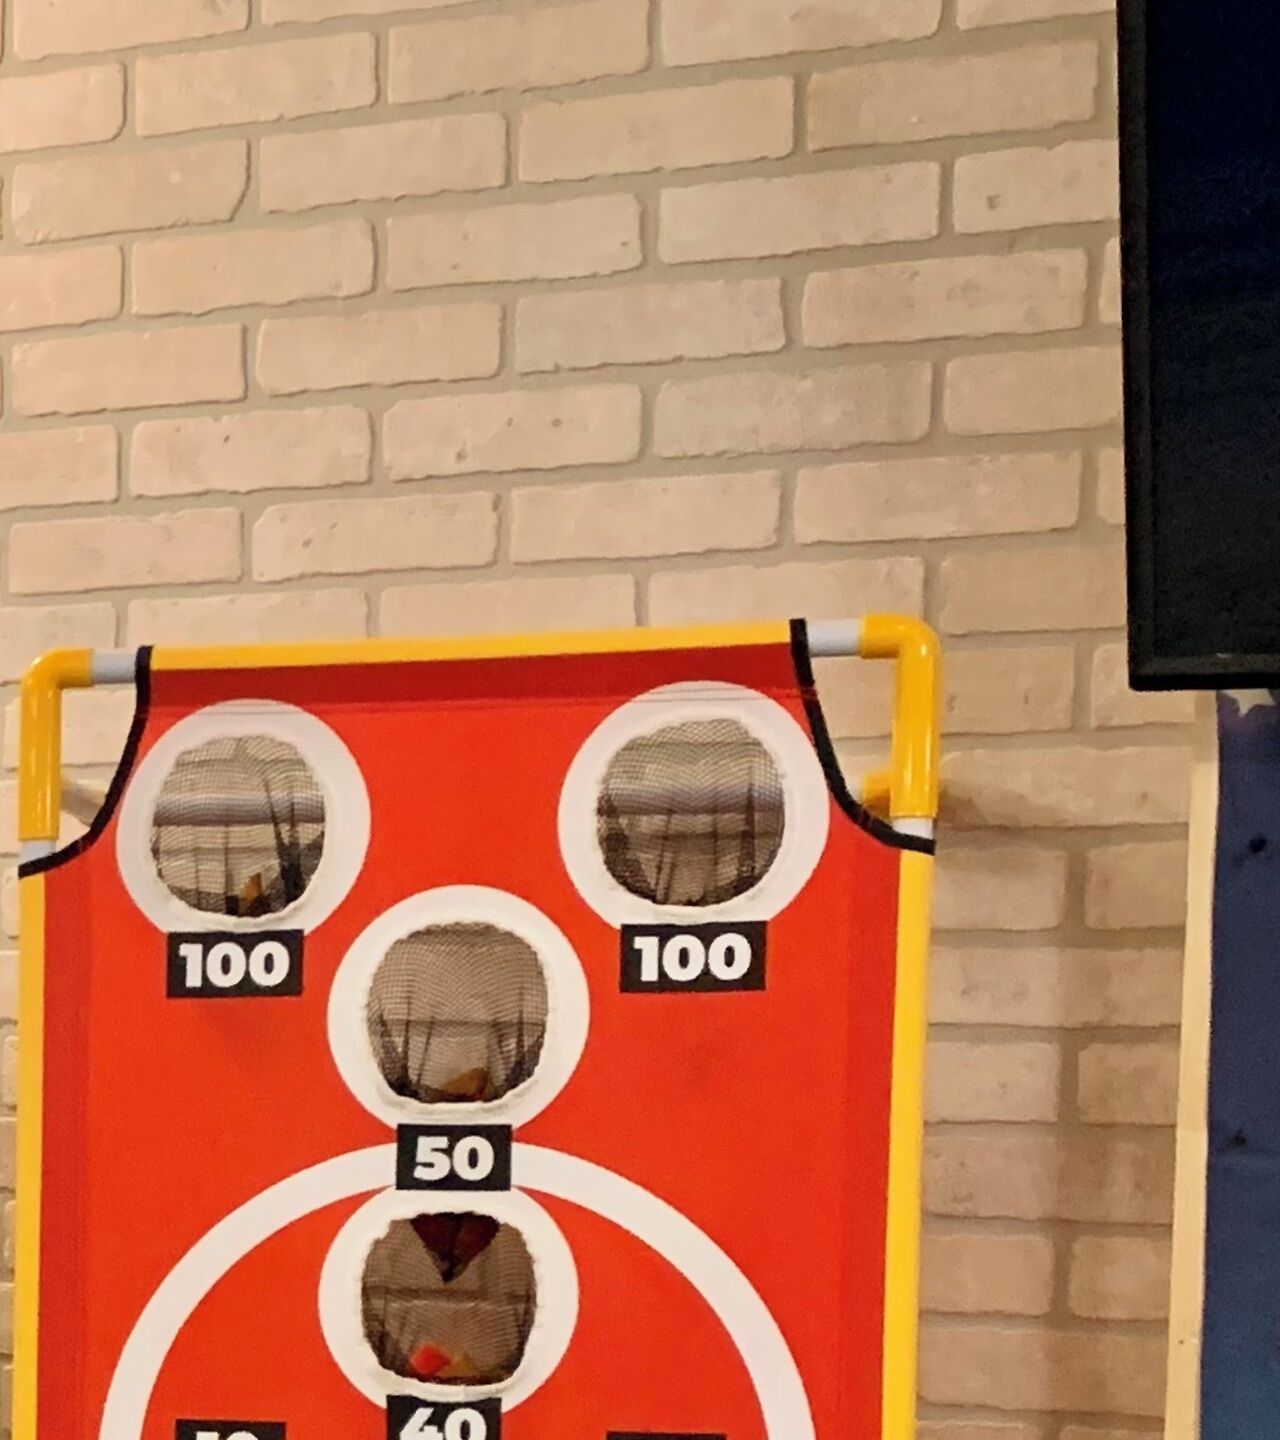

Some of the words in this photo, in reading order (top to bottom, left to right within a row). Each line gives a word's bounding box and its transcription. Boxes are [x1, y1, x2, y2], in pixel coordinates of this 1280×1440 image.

[179, 940, 290, 989] 100
[633, 933, 753, 983] 100
[413, 1135, 495, 1182] 50
